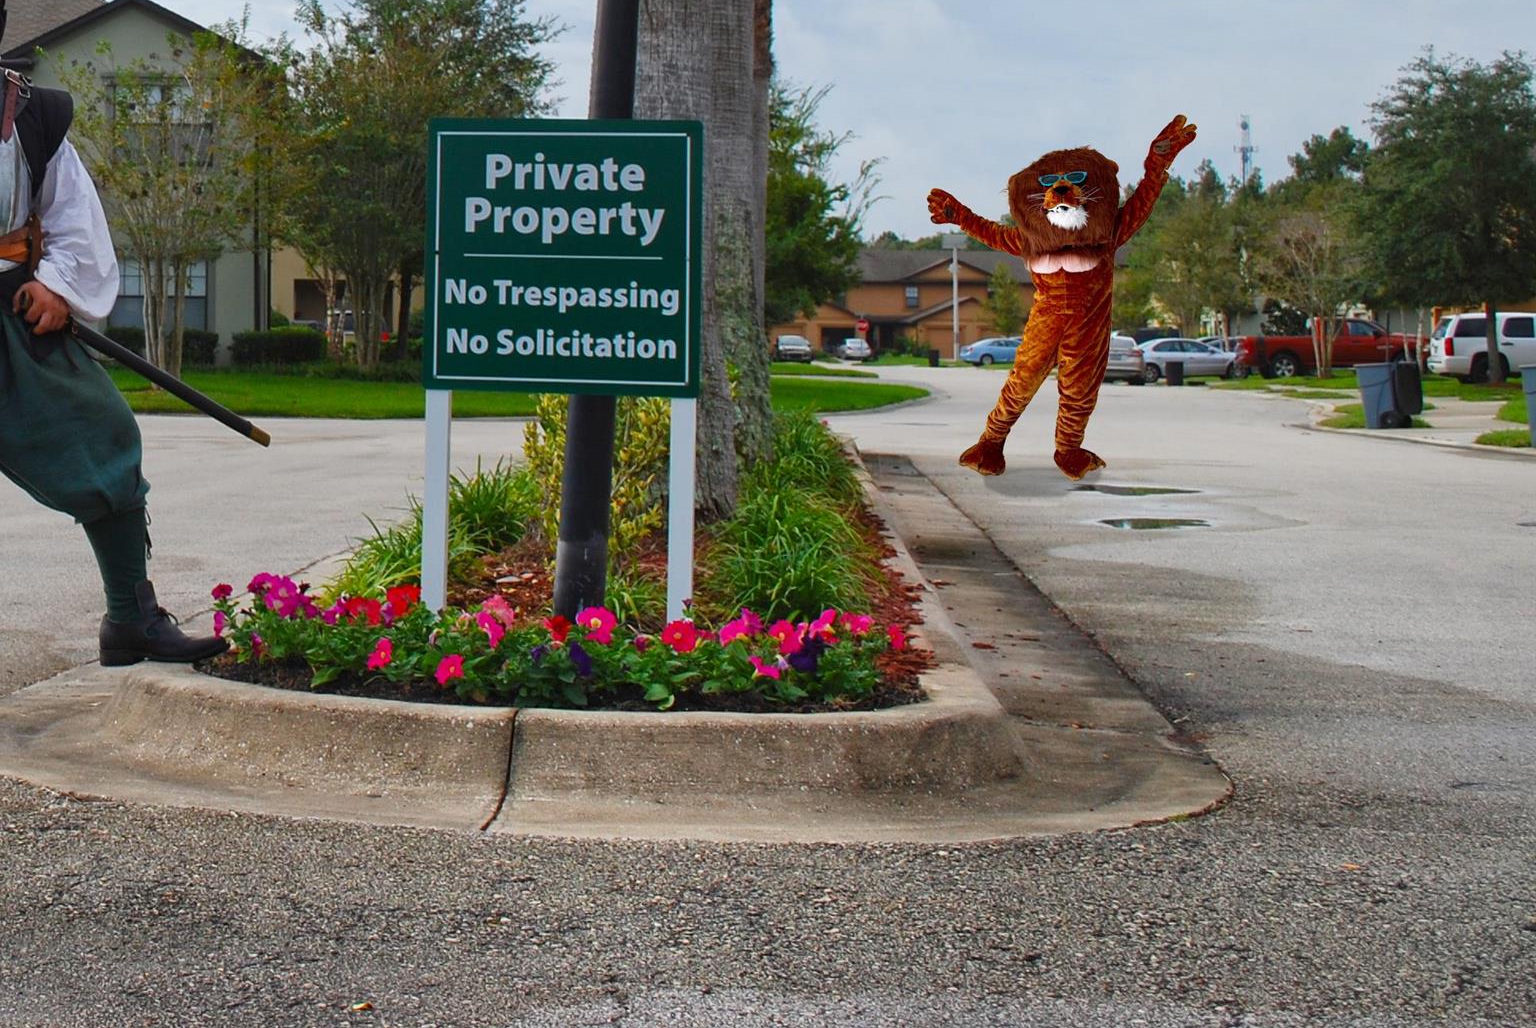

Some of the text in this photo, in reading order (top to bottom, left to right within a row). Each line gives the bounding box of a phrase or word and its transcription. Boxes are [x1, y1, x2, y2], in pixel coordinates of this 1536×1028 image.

[485, 152, 646, 192] Private
[464, 196, 665, 247] Property
[444, 278, 680, 316] No Trespassing
[446, 328, 677, 359] No Solicitation
